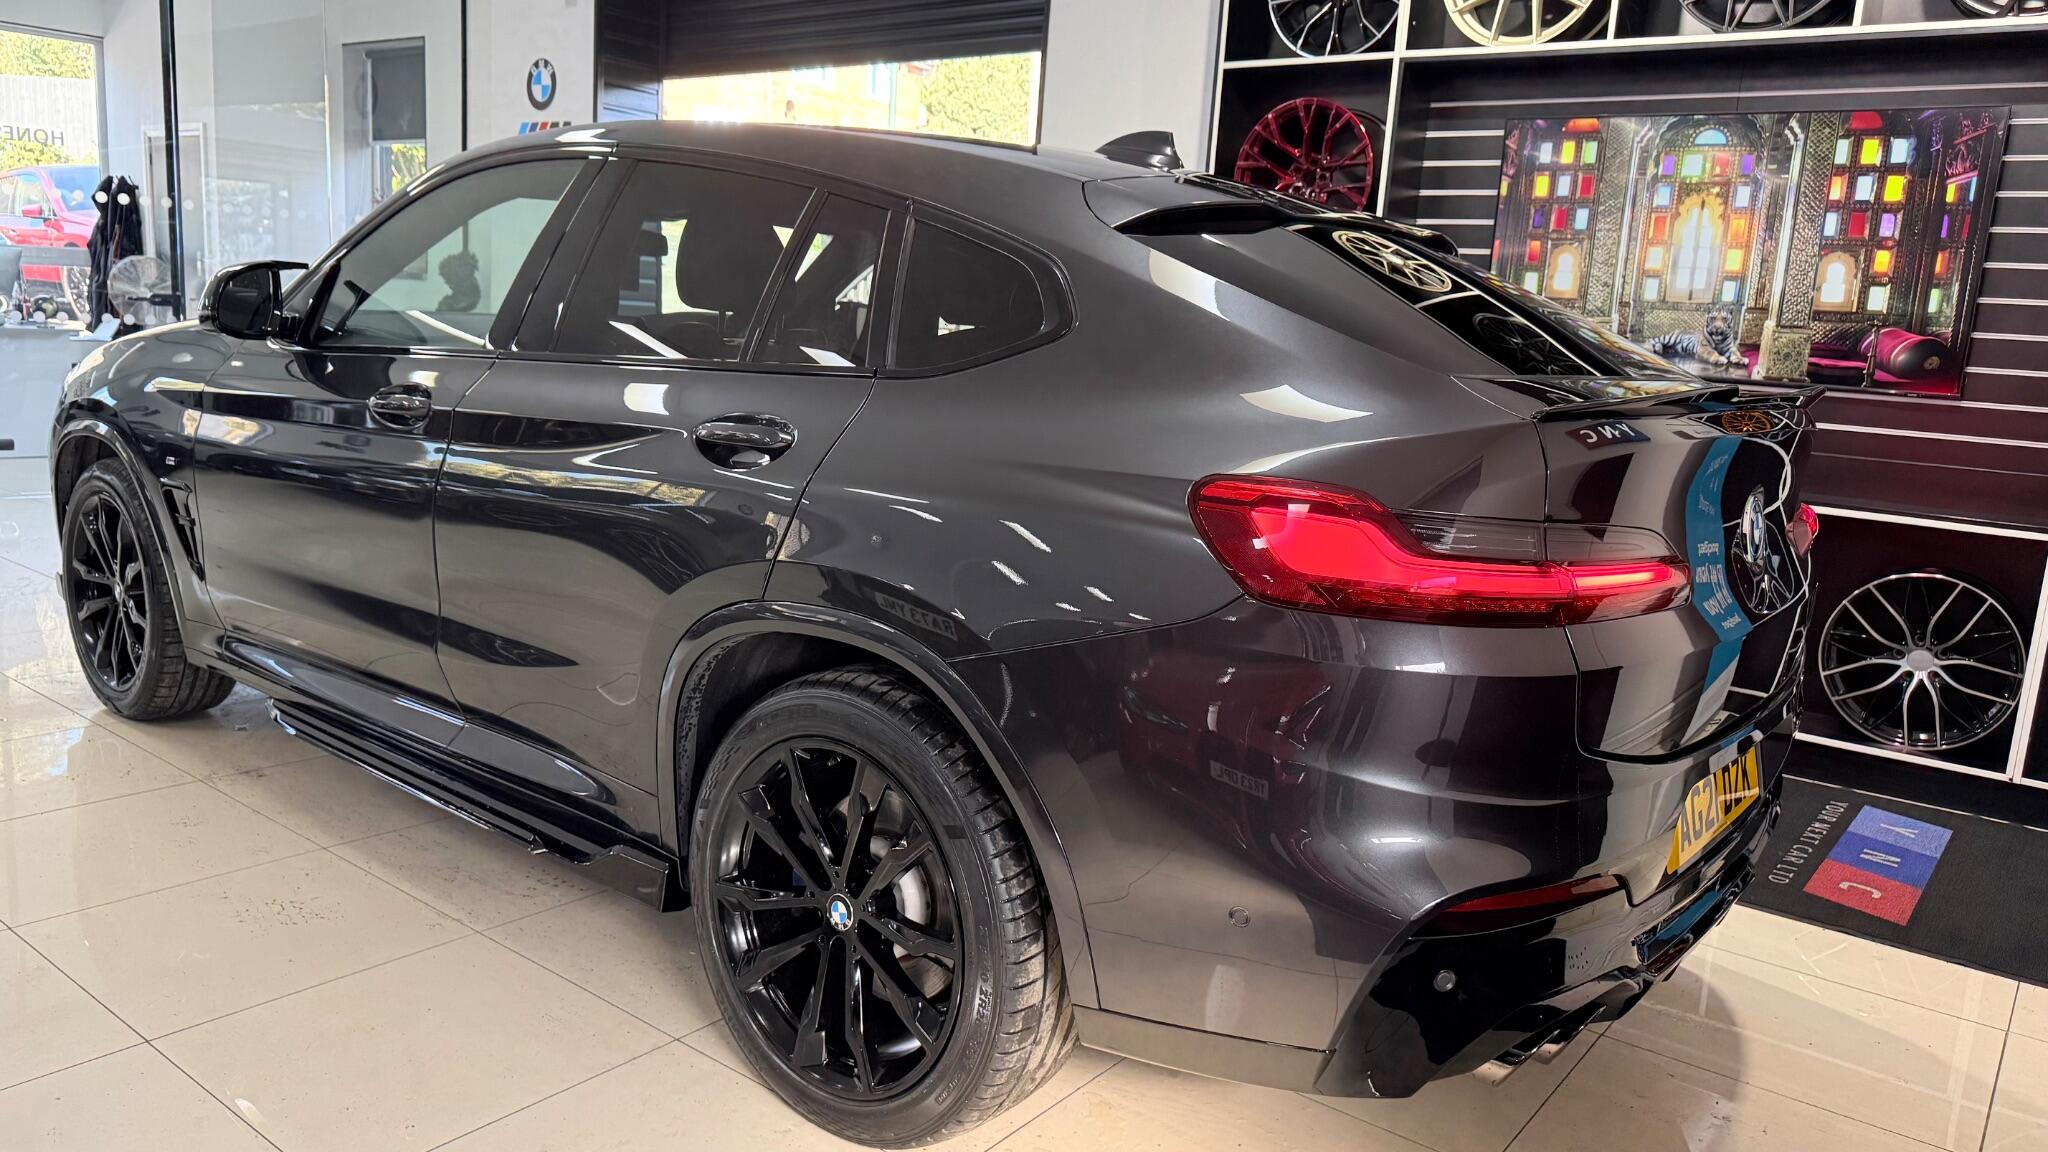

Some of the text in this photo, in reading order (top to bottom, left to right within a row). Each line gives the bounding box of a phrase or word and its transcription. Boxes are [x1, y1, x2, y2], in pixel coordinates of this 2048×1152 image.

[1768, 800, 1849, 885] YOUR NEXT CAR LTD
